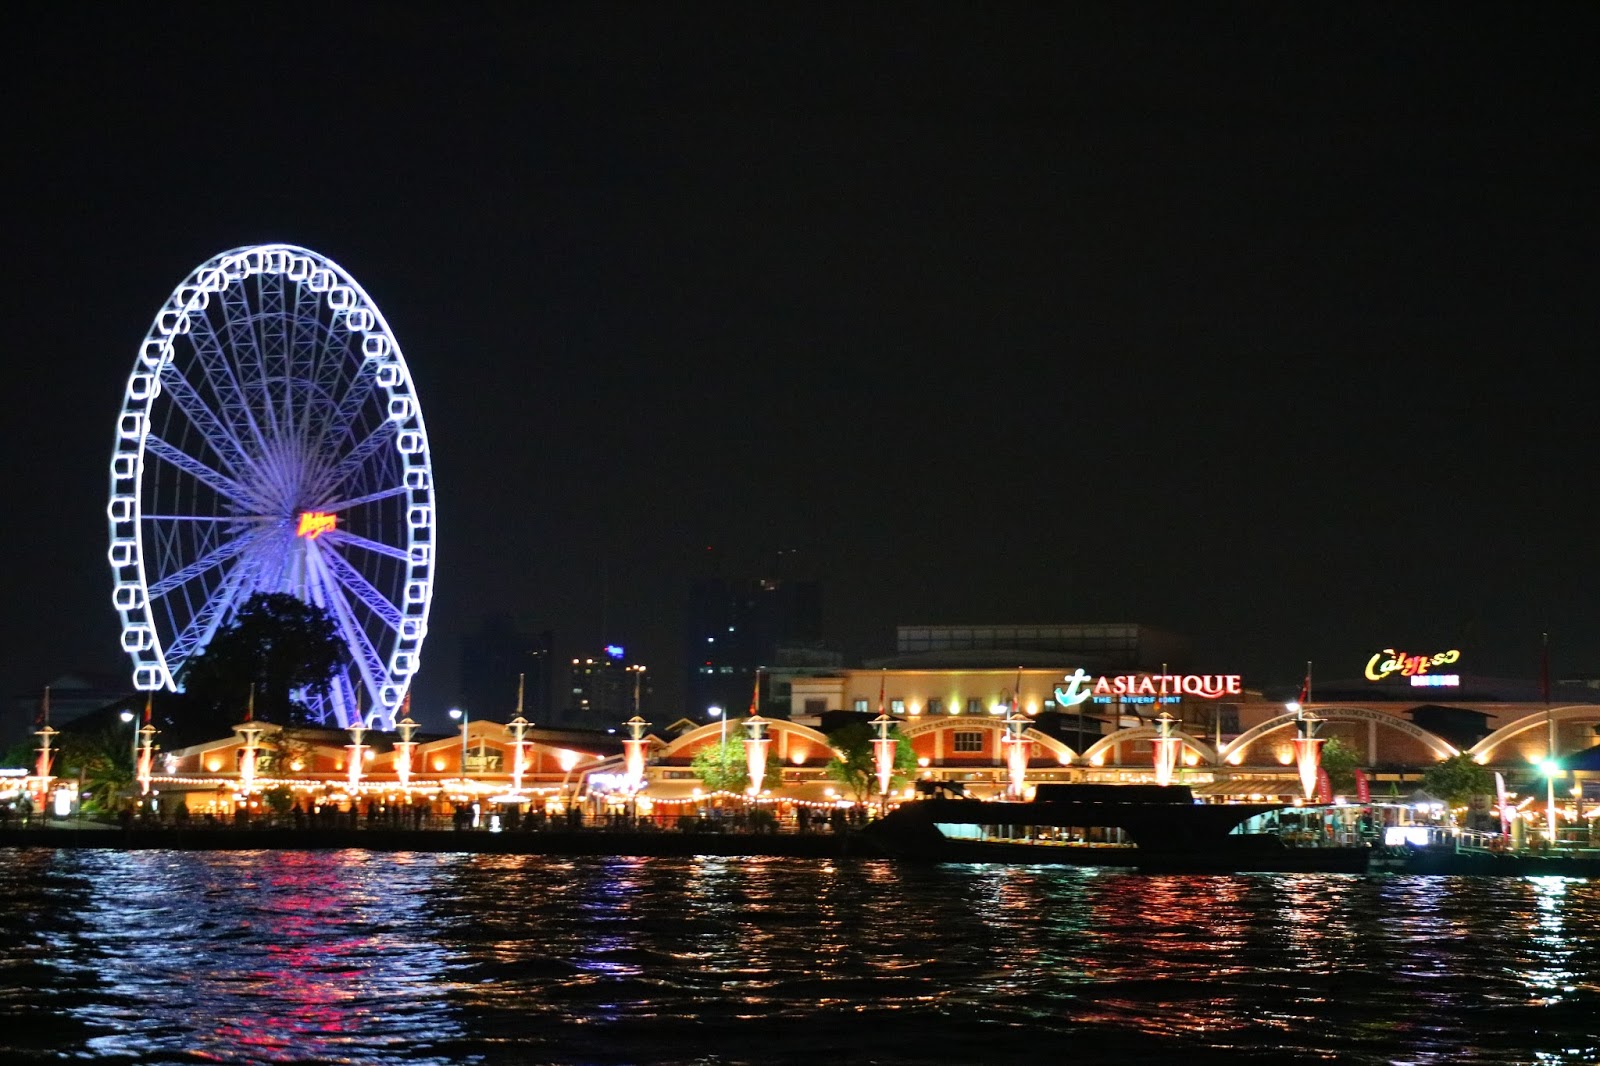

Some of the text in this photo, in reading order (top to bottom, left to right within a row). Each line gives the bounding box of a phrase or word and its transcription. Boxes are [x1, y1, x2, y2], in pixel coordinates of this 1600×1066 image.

[1093, 674, 1242, 698] ASIATIQUE
[1093, 696, 1112, 704] THE
[1031, 743, 1042, 758] 8
[488, 756, 499, 769] 7
